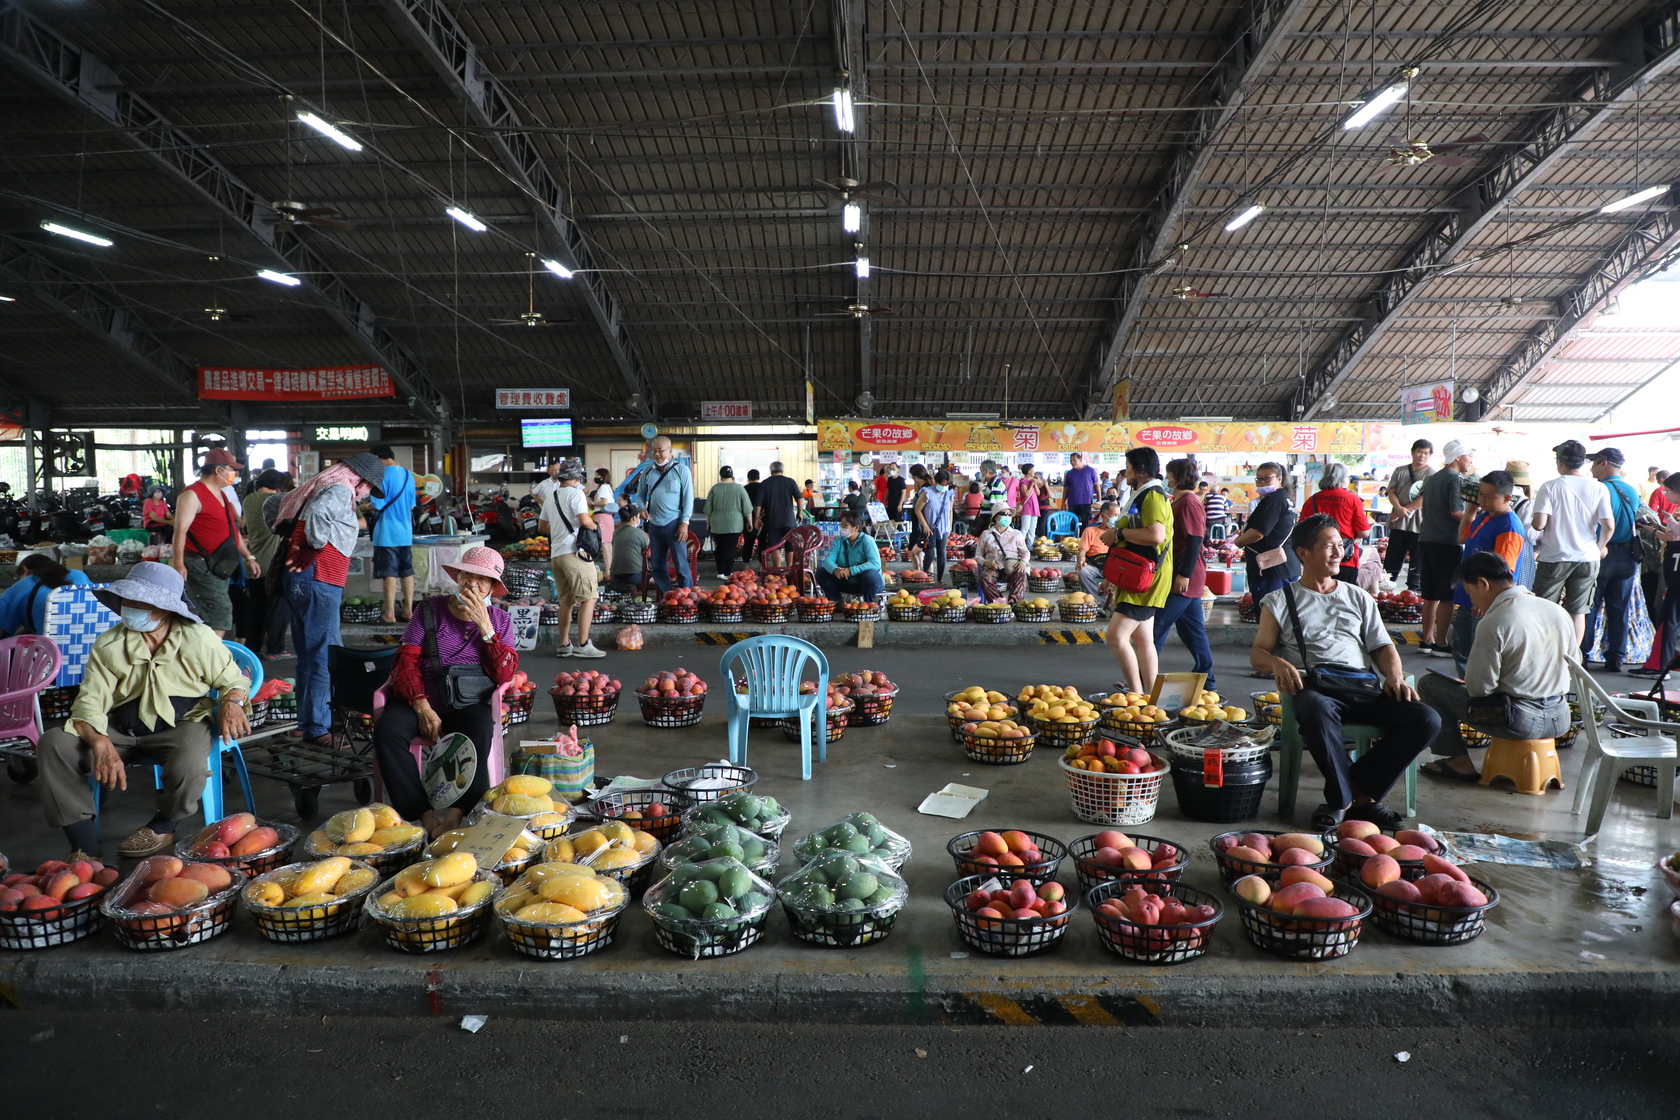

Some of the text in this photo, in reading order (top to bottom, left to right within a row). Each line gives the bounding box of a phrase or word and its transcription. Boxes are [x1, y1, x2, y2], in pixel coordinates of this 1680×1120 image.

[500, 393, 566, 405] 管理費收費處
[861, 428, 913, 439] 芒果の故鄉
[1014, 425, 1040, 450] 菊
[1142, 430, 1193, 441] 芒果の故鄉
[1293, 426, 1318, 451] 菊
[512, 608, 532, 648] 黑美人
